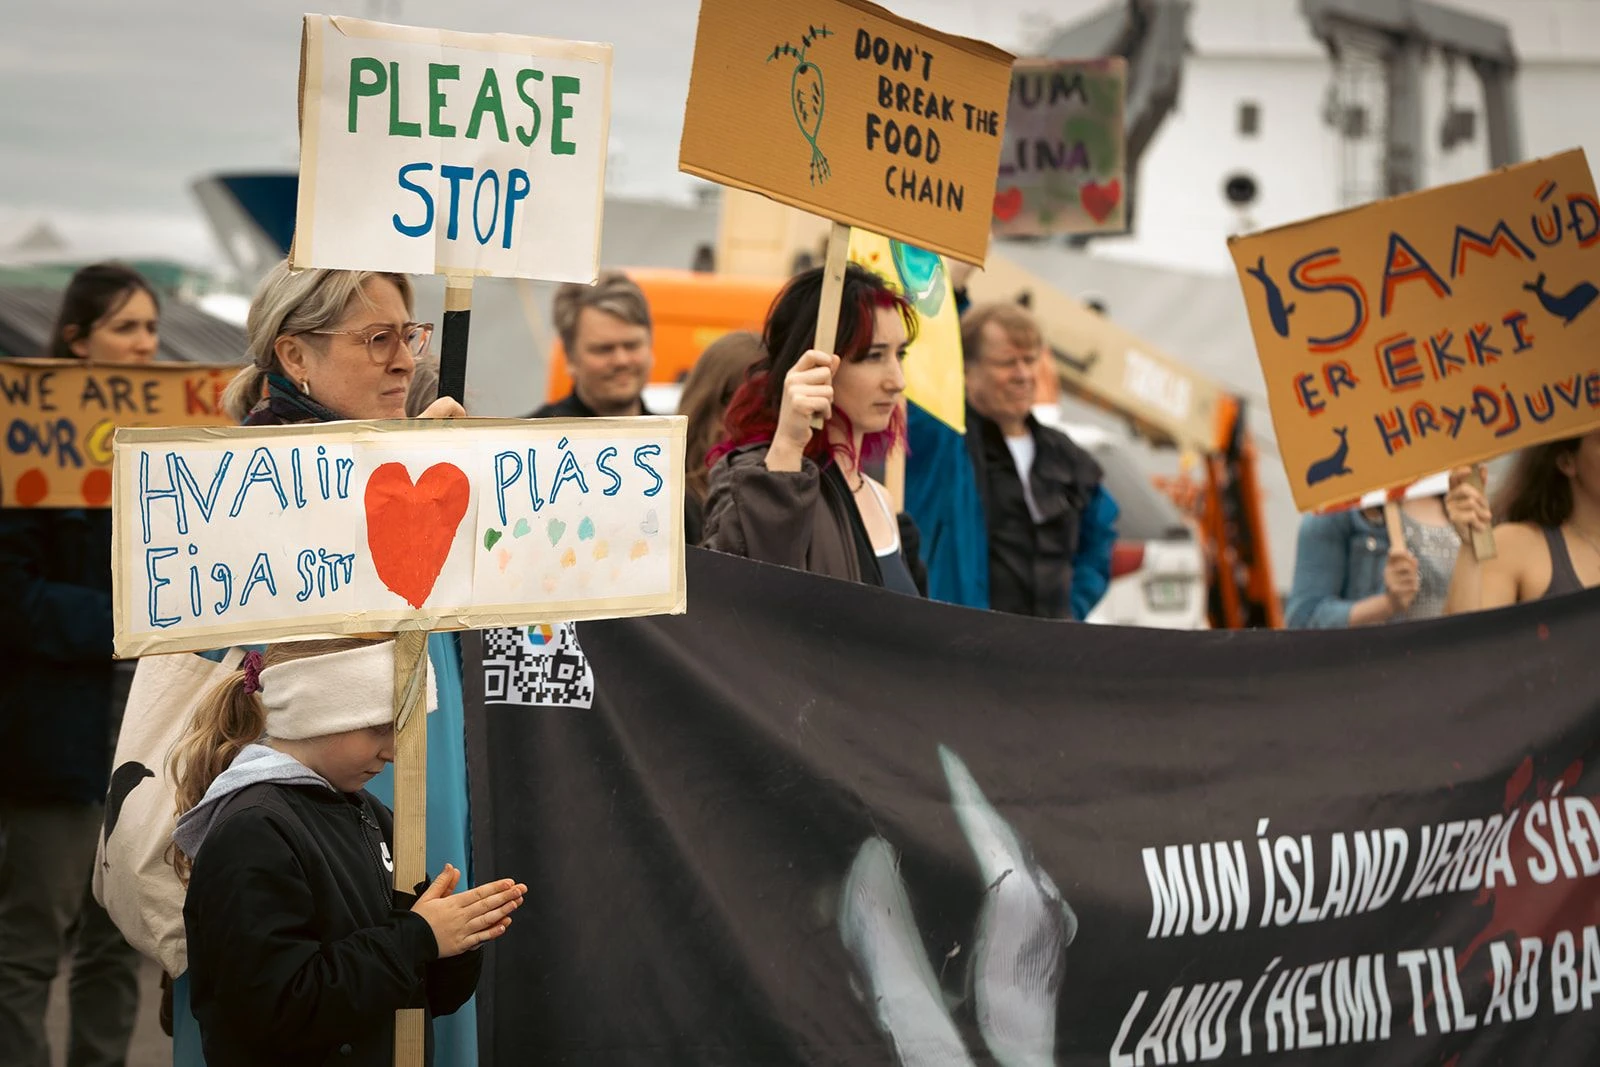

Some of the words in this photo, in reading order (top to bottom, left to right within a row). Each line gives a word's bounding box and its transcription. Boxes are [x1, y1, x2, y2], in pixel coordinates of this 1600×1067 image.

[855, 28, 934, 81] DON'T
[348, 57, 580, 155] PLEASE
[878, 75, 955, 121] BREAK
[963, 103, 999, 137] THE
[1010, 72, 1088, 108] UM
[866, 112, 941, 164] FOOD
[392, 162, 530, 249] STOP
[886, 165, 964, 212] CHAIN
[1292, 359, 1360, 417] ER
[1375, 310, 1534, 392] EKKI
[0, 371, 57, 411] WE
[80, 375, 162, 414] ARE
[7, 418, 84, 467] OUR
[1142, 839, 1250, 939] MUN
[1256, 817, 1409, 928] ÍSLAND
[1110, 978, 1243, 1067] LAND
[1240, 955, 1282, 1056] Í
[1265, 953, 1392, 1053] HEIMI
[1397, 946, 1477, 1036] TIL
